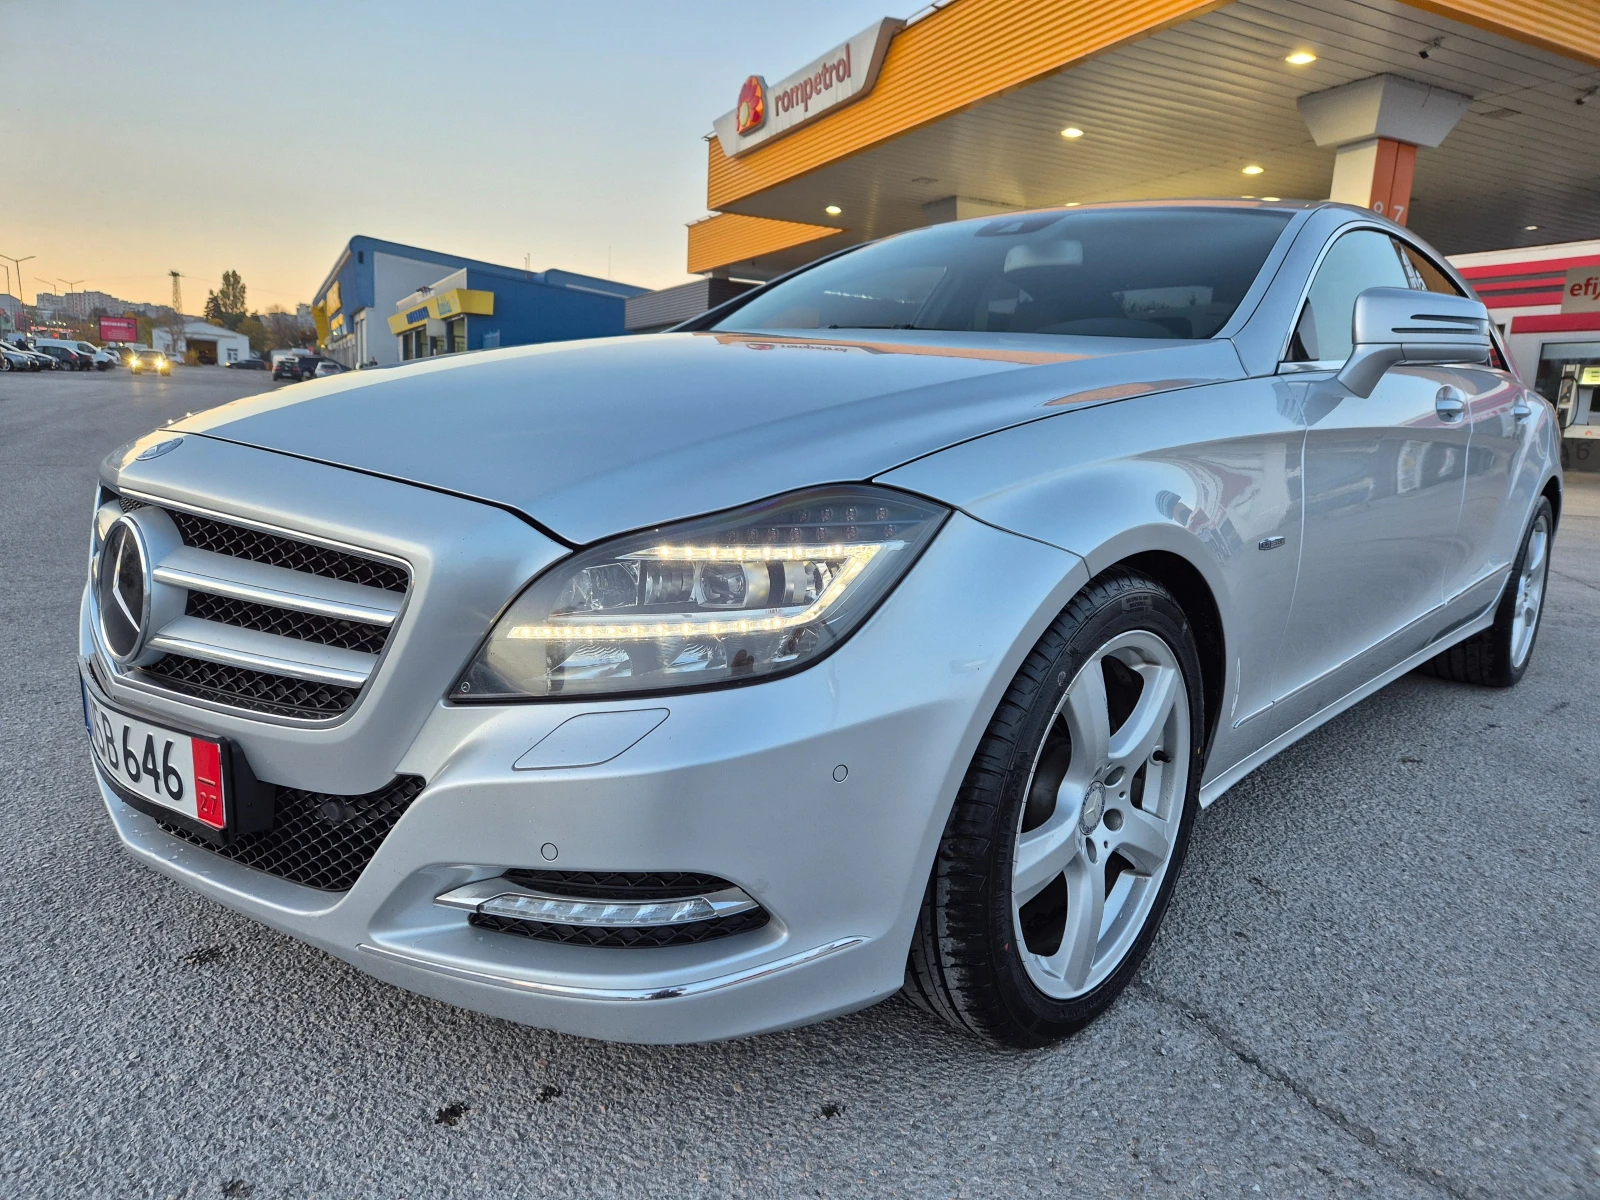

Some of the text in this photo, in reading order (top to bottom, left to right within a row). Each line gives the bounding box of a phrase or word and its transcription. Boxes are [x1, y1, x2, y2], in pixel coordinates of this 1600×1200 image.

[774, 43, 851, 117] rompetrol
[1393, 204, 1405, 223] 7
[122, 723, 184, 801] 646
[199, 791, 218, 816] 27
